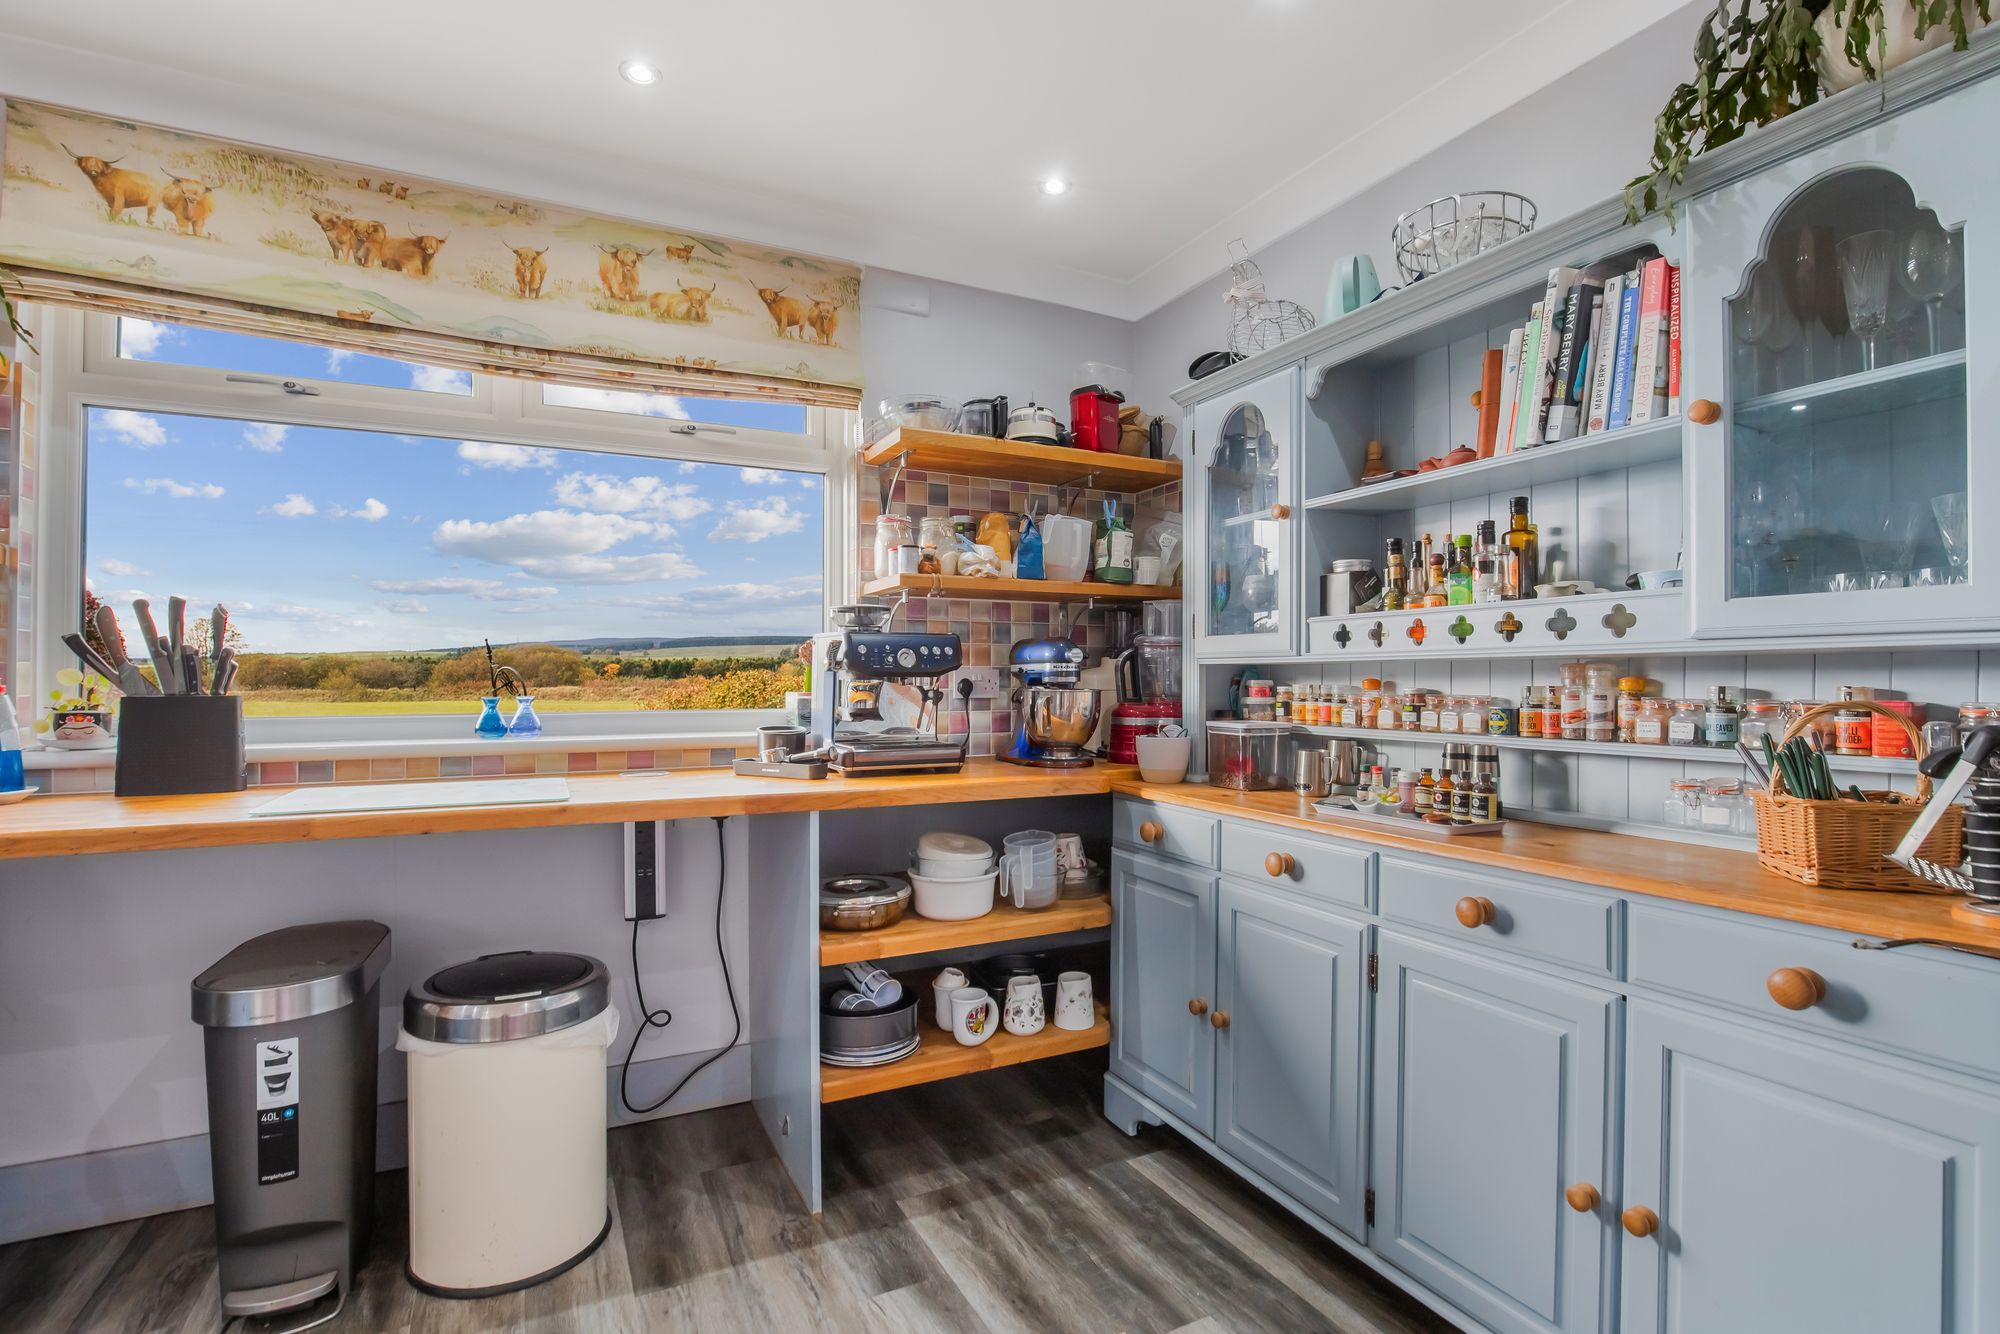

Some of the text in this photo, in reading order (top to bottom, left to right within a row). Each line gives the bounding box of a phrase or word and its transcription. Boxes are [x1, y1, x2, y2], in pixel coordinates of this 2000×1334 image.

[1624, 296, 1632, 313] THE
[1670, 270, 1680, 340] INSPIRALIZED
[1559, 293, 1578, 372] MARY BERRY
[1619, 314, 1630, 353] COMPLETE
[1642, 321, 1656, 360] MARY
[1598, 364, 1607, 387] BERRY
[1612, 373, 1623, 413] COOKBOOK
[1637, 365, 1651, 407] BERRY
[1595, 386, 1604, 410] MARY
[1713, 724, 1733, 732] LEAVES
[260, 1112, 279, 1122] 40L
